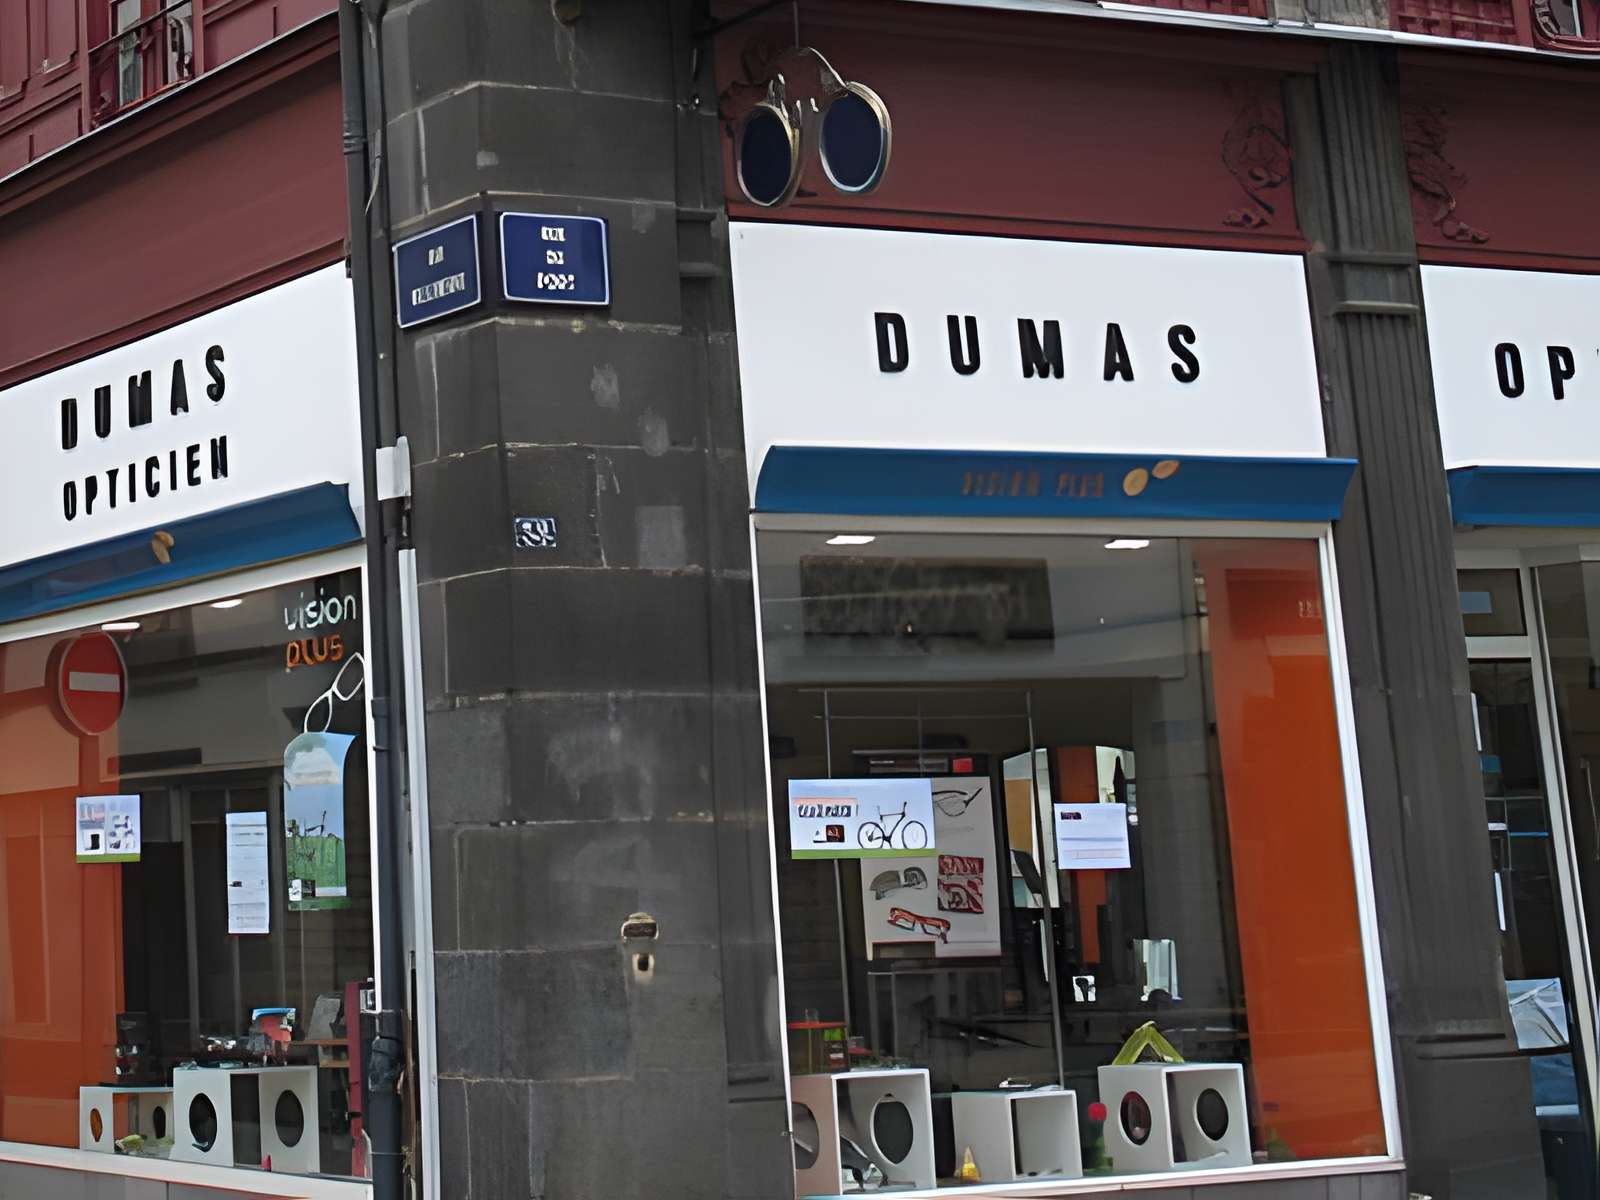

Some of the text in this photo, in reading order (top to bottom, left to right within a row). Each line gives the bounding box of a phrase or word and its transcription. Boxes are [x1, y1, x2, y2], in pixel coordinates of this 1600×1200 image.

[873, 311, 1201, 384] DUMAS
[1494, 341, 1600, 401] OP
[61, 344, 226, 451] DUMAS
[62, 434, 229, 522] OPTICIEN
[283, 586, 357, 631] vision
[285, 632, 345, 673] plus
